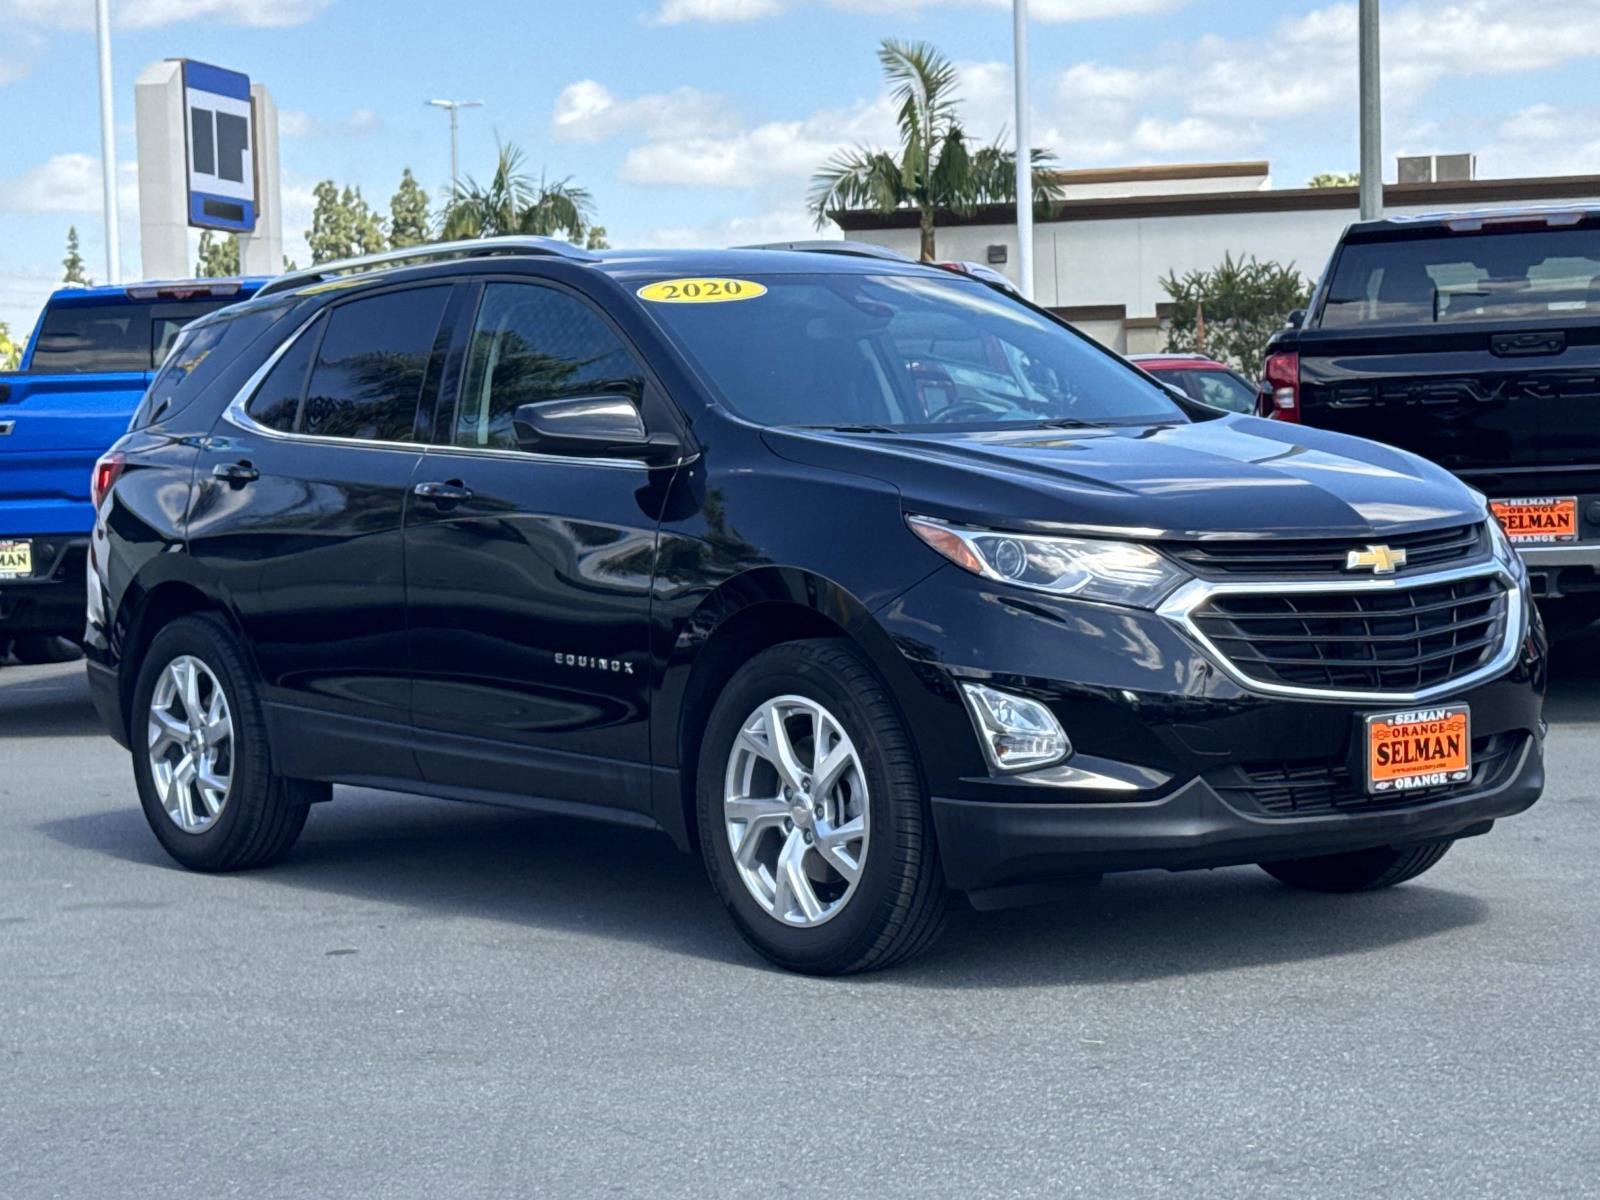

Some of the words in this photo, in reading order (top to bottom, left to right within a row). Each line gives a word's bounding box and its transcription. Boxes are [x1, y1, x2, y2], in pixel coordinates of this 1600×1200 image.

[662, 281, 742, 299] 2020
[1508, 506, 1555, 514] ORANGE
[1510, 535, 1556, 543] ORANGE
[554, 652, 634, 675] EQUINOX
[1394, 709, 1446, 725] SELMAN
[1392, 723, 1446, 738] ORANGE
[1376, 733, 1461, 767] SELMAN
[1394, 772, 1448, 790] ORANGE
